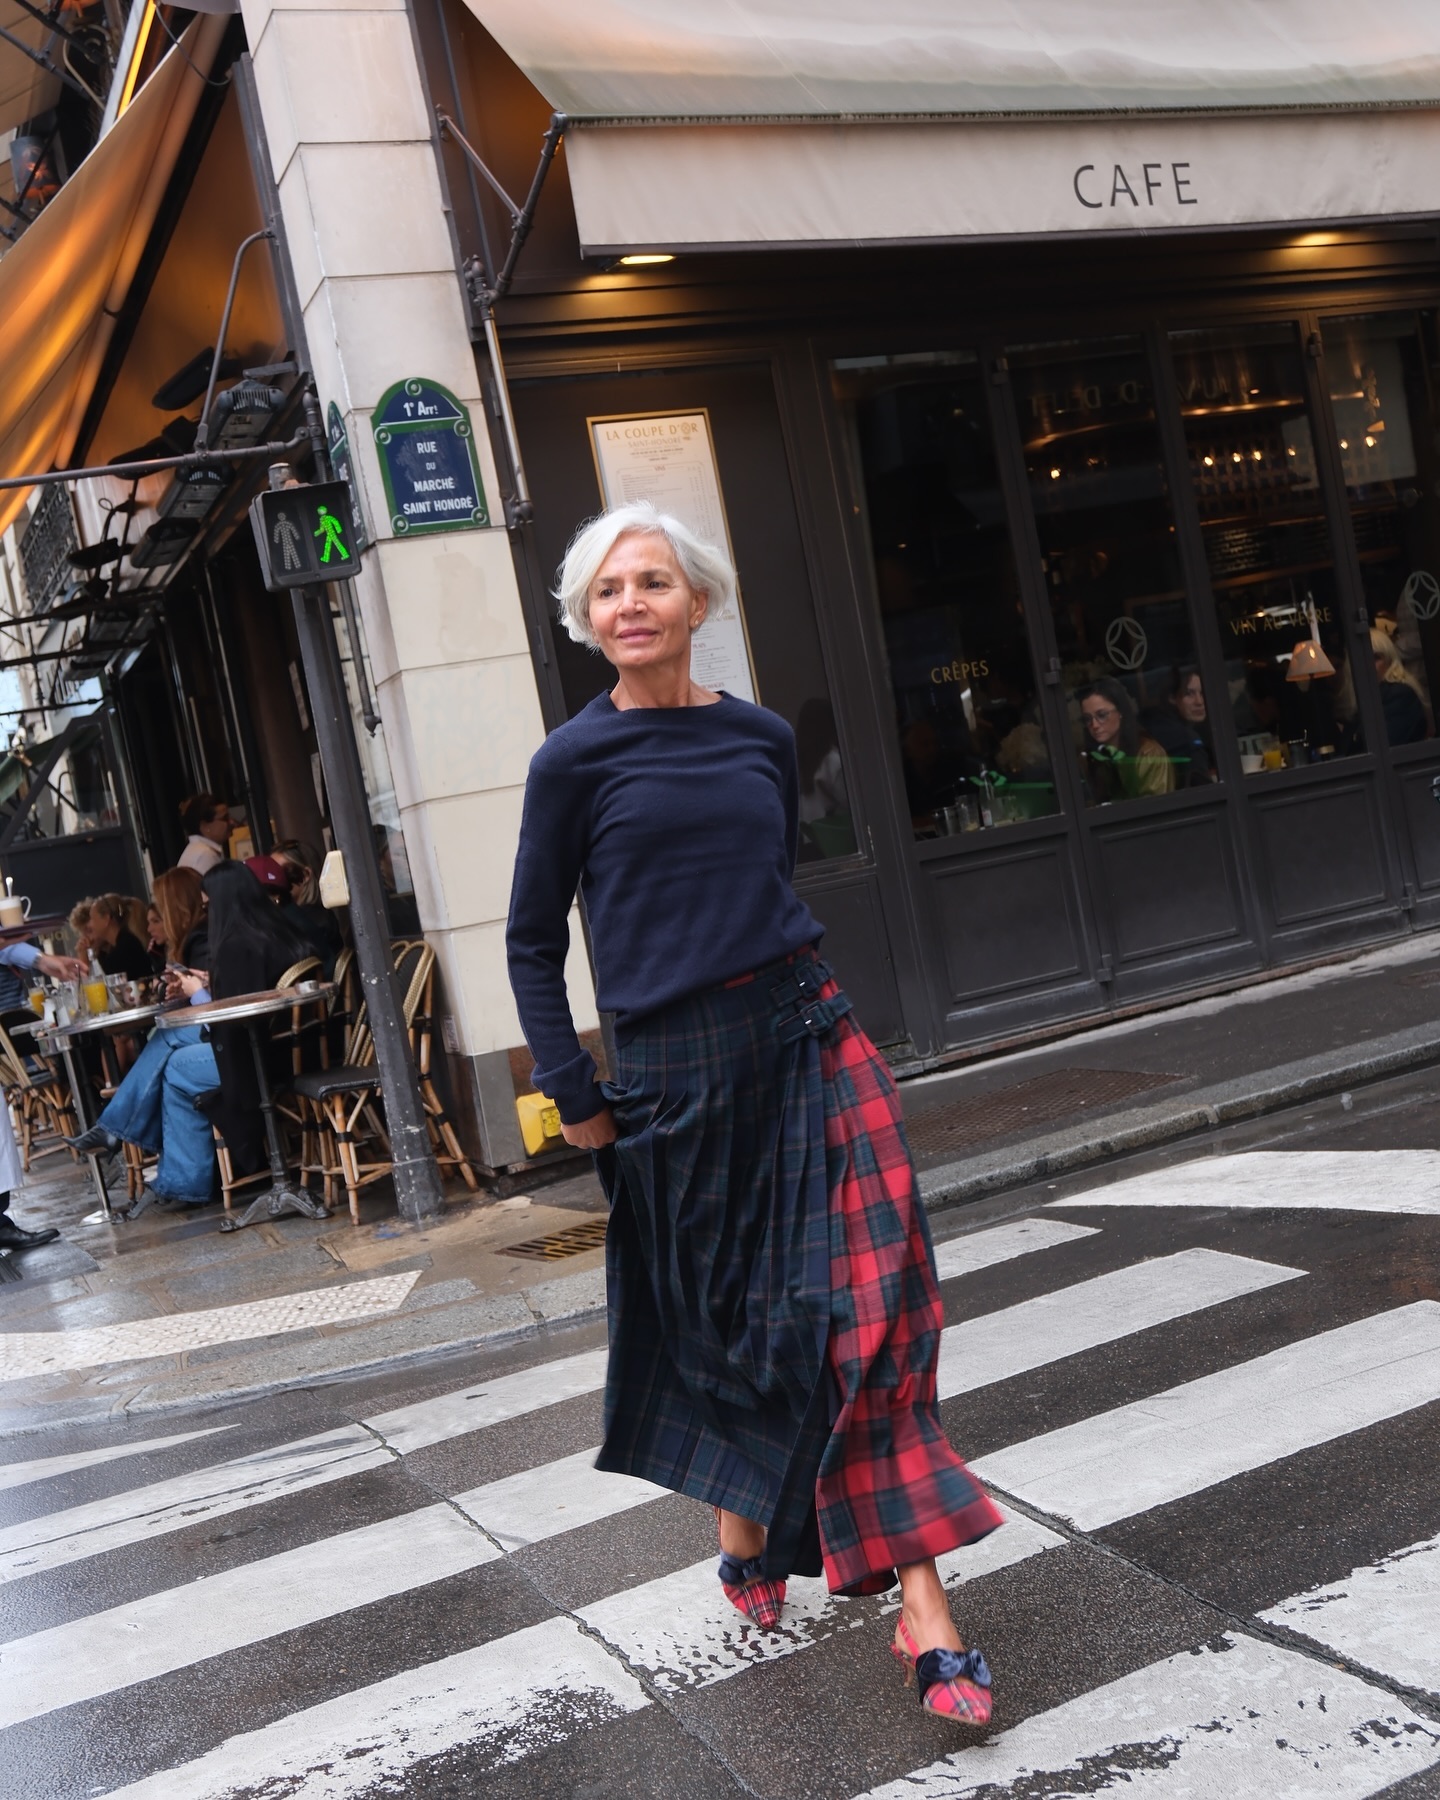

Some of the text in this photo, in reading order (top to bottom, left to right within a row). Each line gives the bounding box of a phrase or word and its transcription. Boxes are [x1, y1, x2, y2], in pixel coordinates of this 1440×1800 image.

[1073, 162, 1198, 209] CAFE
[605, 429, 621, 441] LA
[624, 425, 665, 439] COUPE
[416, 441, 438, 454] RUE
[425, 462, 437, 471] DU
[402, 501, 432, 515] SAINT
[1230, 618, 1257, 636] VIN
[930, 659, 990, 684] CRÊPES
